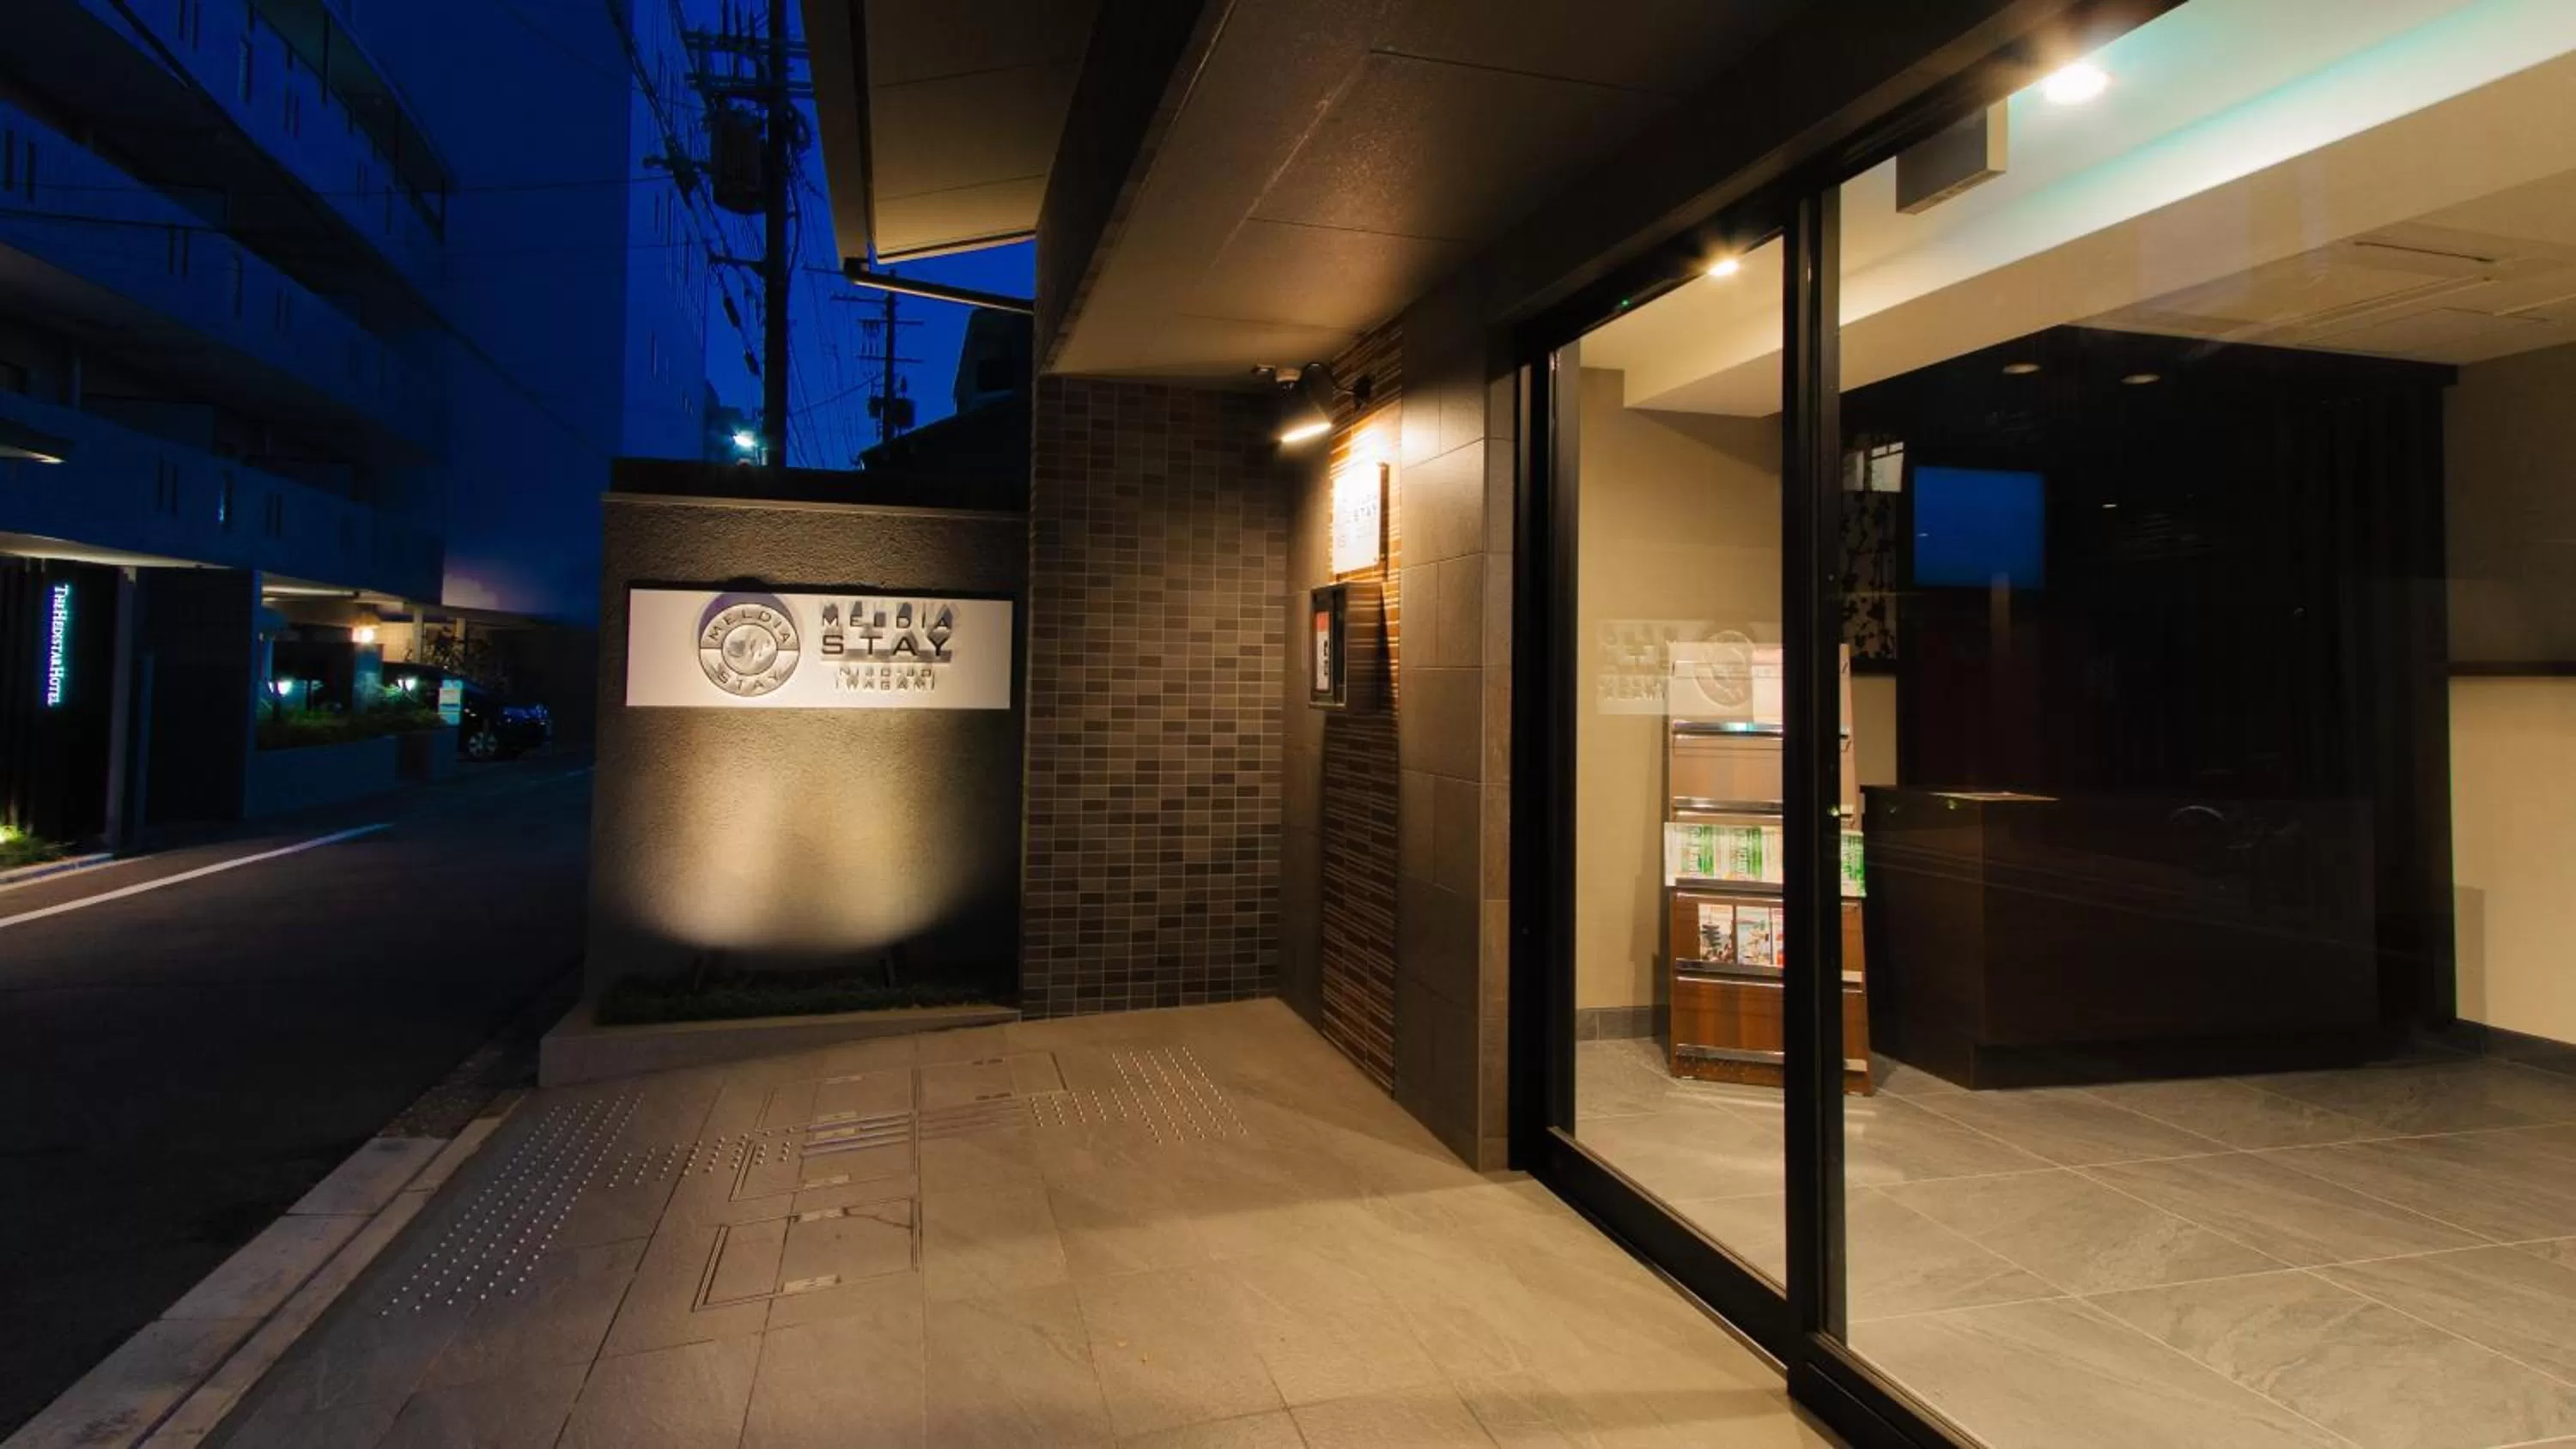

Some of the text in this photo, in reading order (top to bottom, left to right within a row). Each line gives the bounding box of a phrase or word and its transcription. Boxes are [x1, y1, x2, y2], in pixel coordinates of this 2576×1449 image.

[708, 608, 791, 643] MELDIA
[822, 613, 952, 629] MELDIA
[822, 634, 951, 657] STAY
[716, 670, 779, 691] STAY
